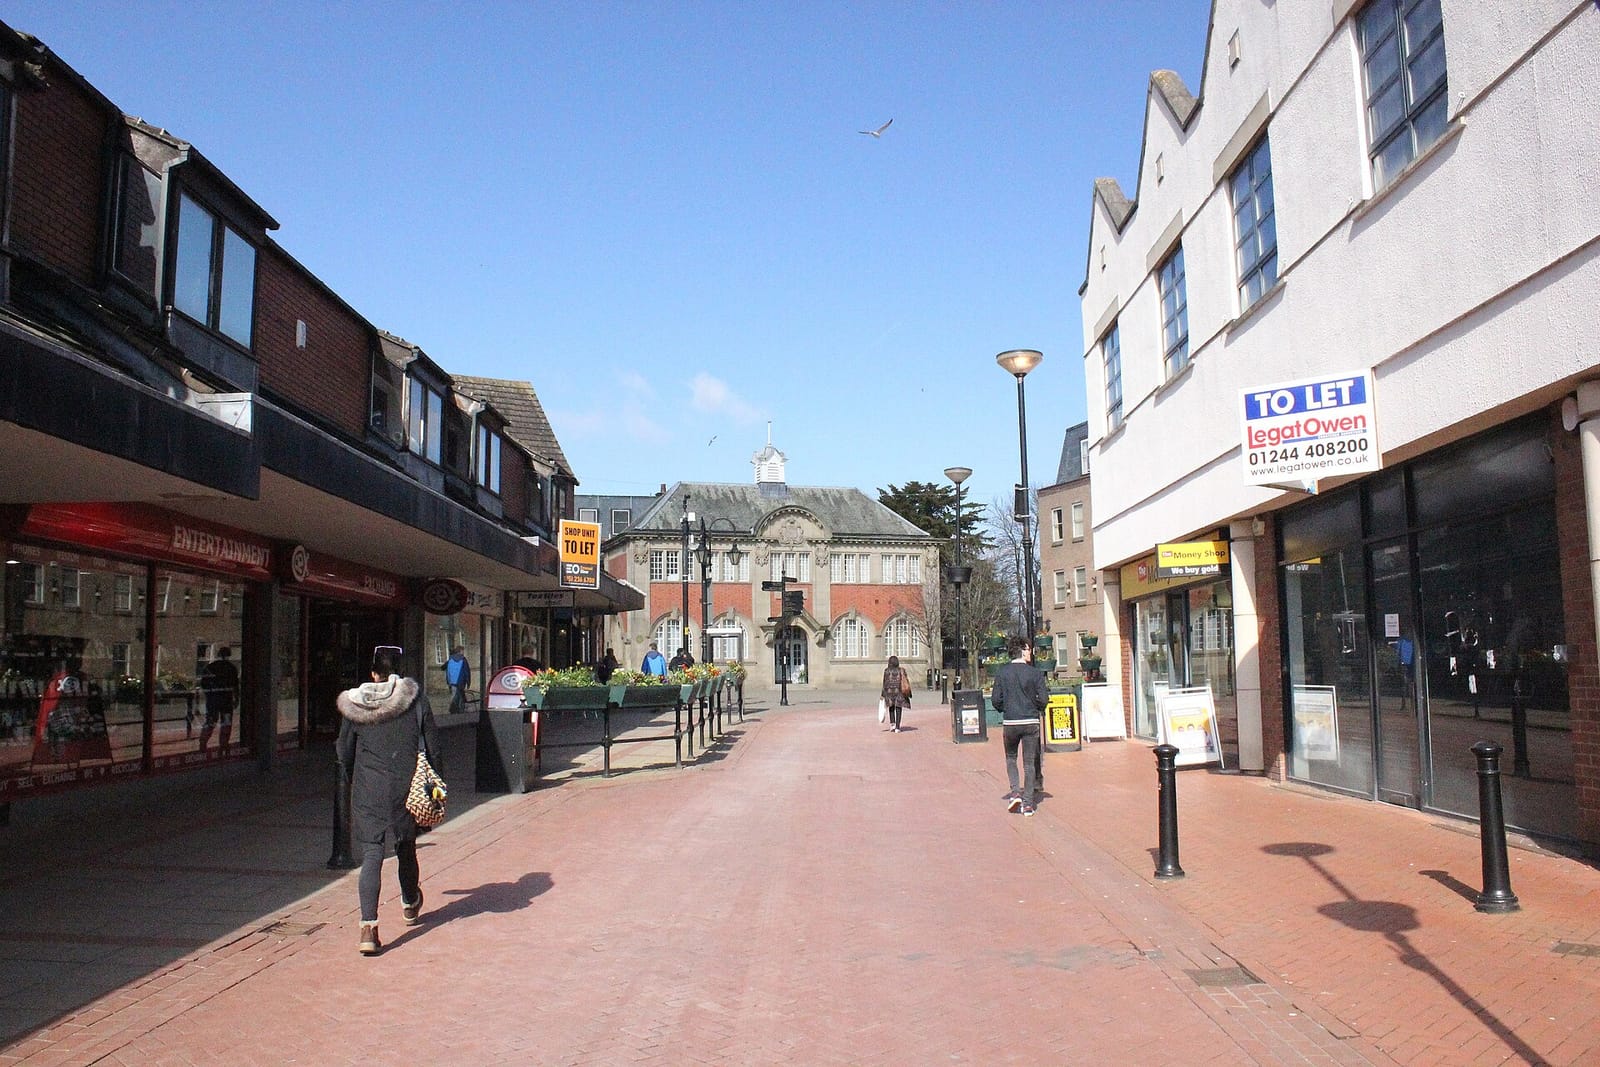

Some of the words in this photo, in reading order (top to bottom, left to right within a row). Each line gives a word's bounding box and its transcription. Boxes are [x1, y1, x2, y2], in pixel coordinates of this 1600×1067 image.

[1255, 389, 1295, 417] TO
[1305, 379, 1354, 410] LET
[1247, 414, 1367, 449] LegatOwen
[1249, 447, 1299, 465] 01244
[1305, 438, 1368, 458] 408200
[1250, 454, 1368, 476] www.legatowen.co.uk
[564, 527, 581, 537] SHOP
[582, 529, 595, 538] UNIT
[173, 525, 270, 568] ENTERTAINMENT
[564, 540, 578, 554] TO
[580, 541, 595, 556] LET
[1173, 550, 1202, 559] Money
[1204, 549, 1226, 559] Shop
[1171, 567, 1184, 575] We
[1185, 566, 1200, 575] buy
[1201, 564, 1219, 575] gold
[42, 770, 77, 785] EXCHANGE
